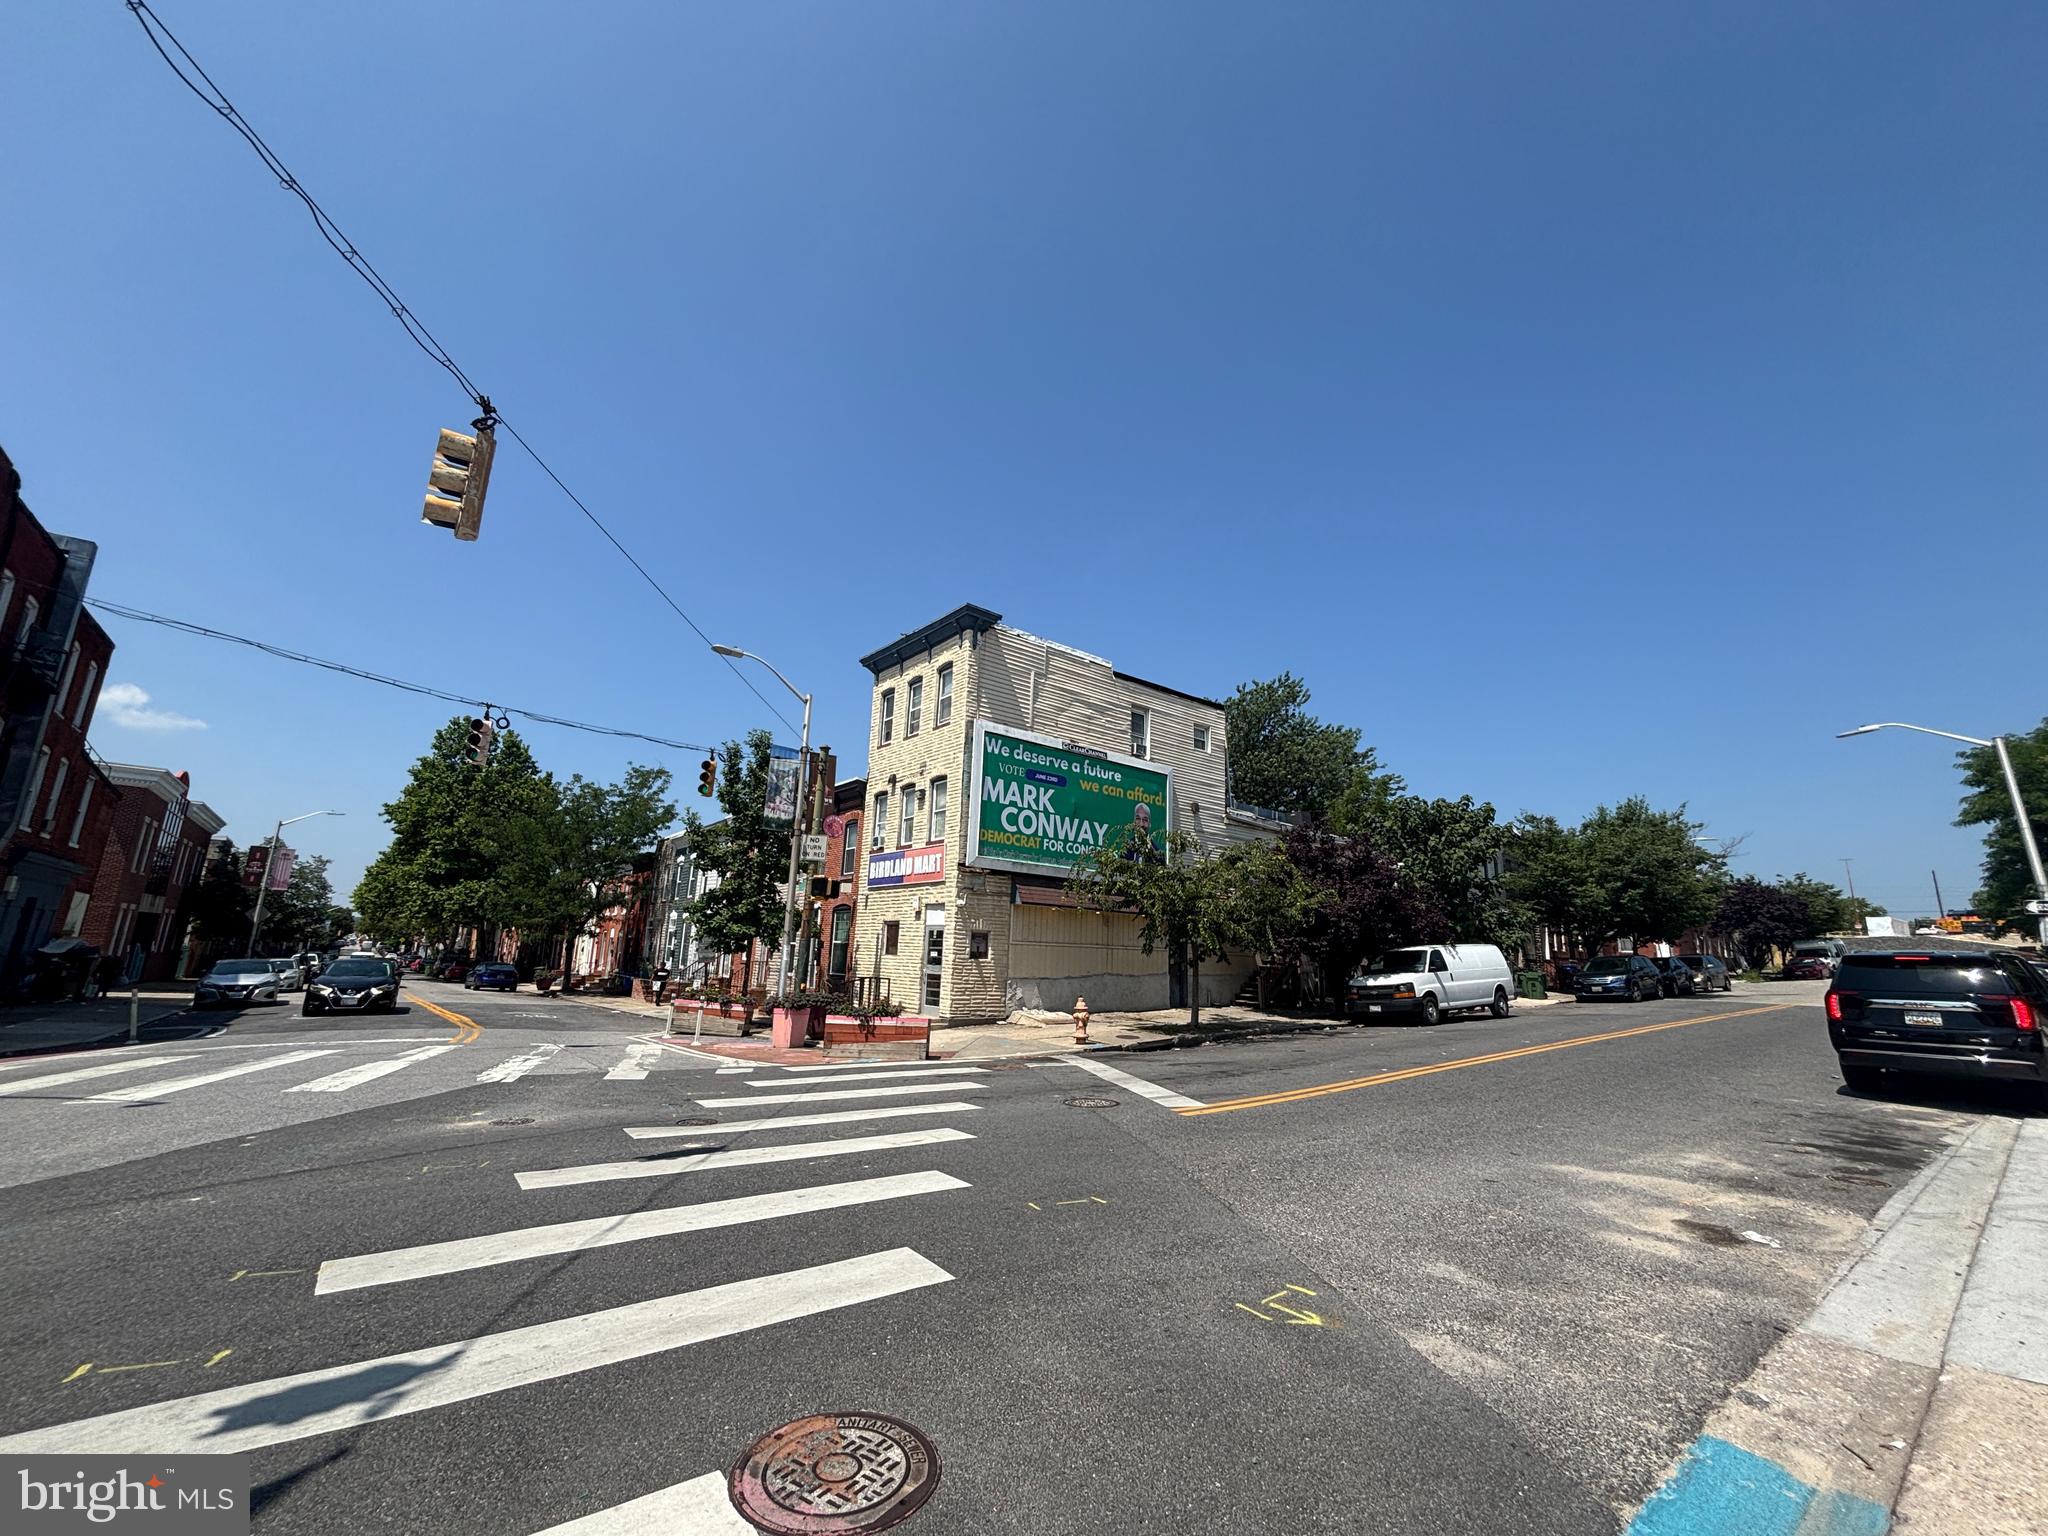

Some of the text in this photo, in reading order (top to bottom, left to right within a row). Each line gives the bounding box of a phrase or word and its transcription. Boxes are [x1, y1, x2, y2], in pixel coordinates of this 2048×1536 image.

[985, 737, 1122, 782] We deserve a future
[999, 763, 1026, 777] VOTE
[982, 776, 1055, 813] MARK
[1080, 780, 1165, 806] we can afford.
[1001, 806, 1109, 846] CONWAY
[980, 829, 1041, 848] DEMOCRAT
[1043, 839, 1064, 853] FOR
[869, 853, 942, 879] BIRDLAND MART
[902, 1434, 927, 1464] SEWER
